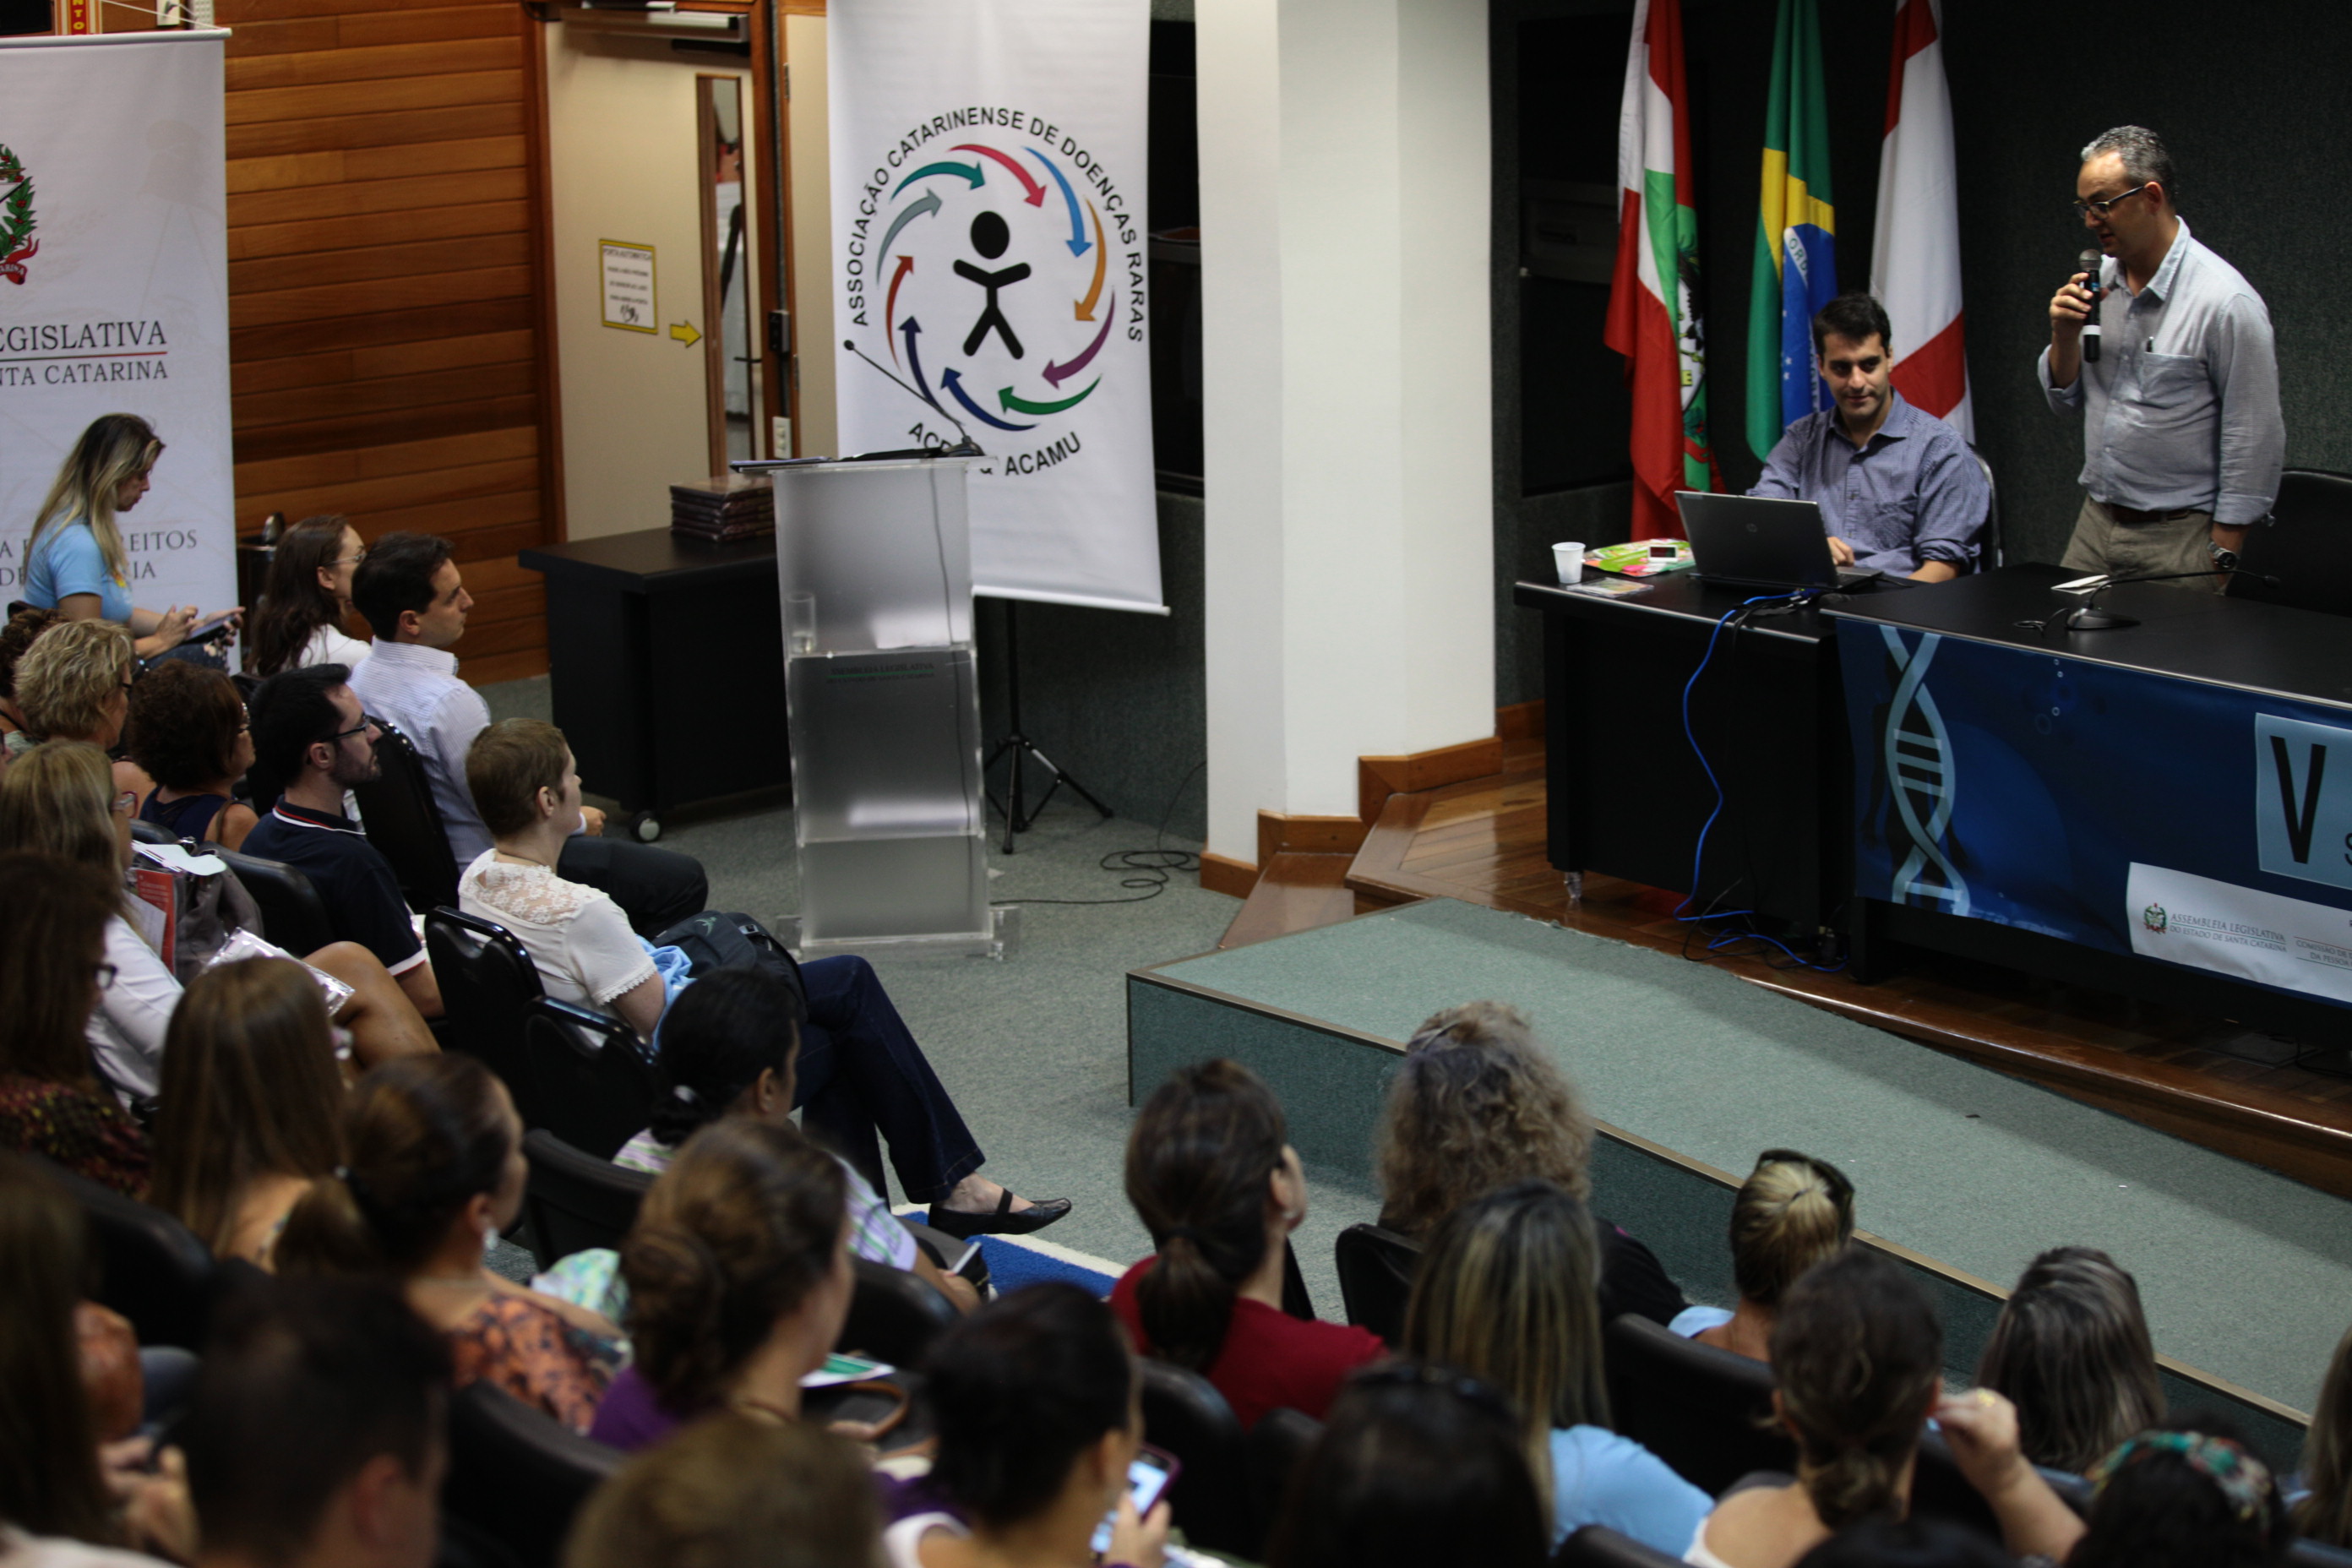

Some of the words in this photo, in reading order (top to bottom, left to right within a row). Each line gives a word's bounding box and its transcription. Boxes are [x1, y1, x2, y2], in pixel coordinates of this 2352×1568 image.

[847, 168, 890, 327] ASSOCIAÇÃO
[887, 106, 1025, 169] CATARINENSE
[1029, 117, 1059, 145] DE
[1060, 137, 1137, 247] DOENÇAS
[1126, 252, 1145, 342] RARAS
[0, 366, 36, 386] TA
[45, 361, 168, 384] CATARINA
[1004, 431, 1081, 476] ACAMU
[2269, 735, 2328, 865] V
[2169, 925, 2180, 934] DO
[2183, 927, 2211, 939] ESTADO
[2212, 933, 2223, 941] DE
[2224, 934, 2248, 946] SANTA
[2250, 939, 2287, 953] CATARINA
[2170, 913, 2227, 930] ASSEMBLEIA
[2230, 923, 2285, 942] LEGISLATIVA
